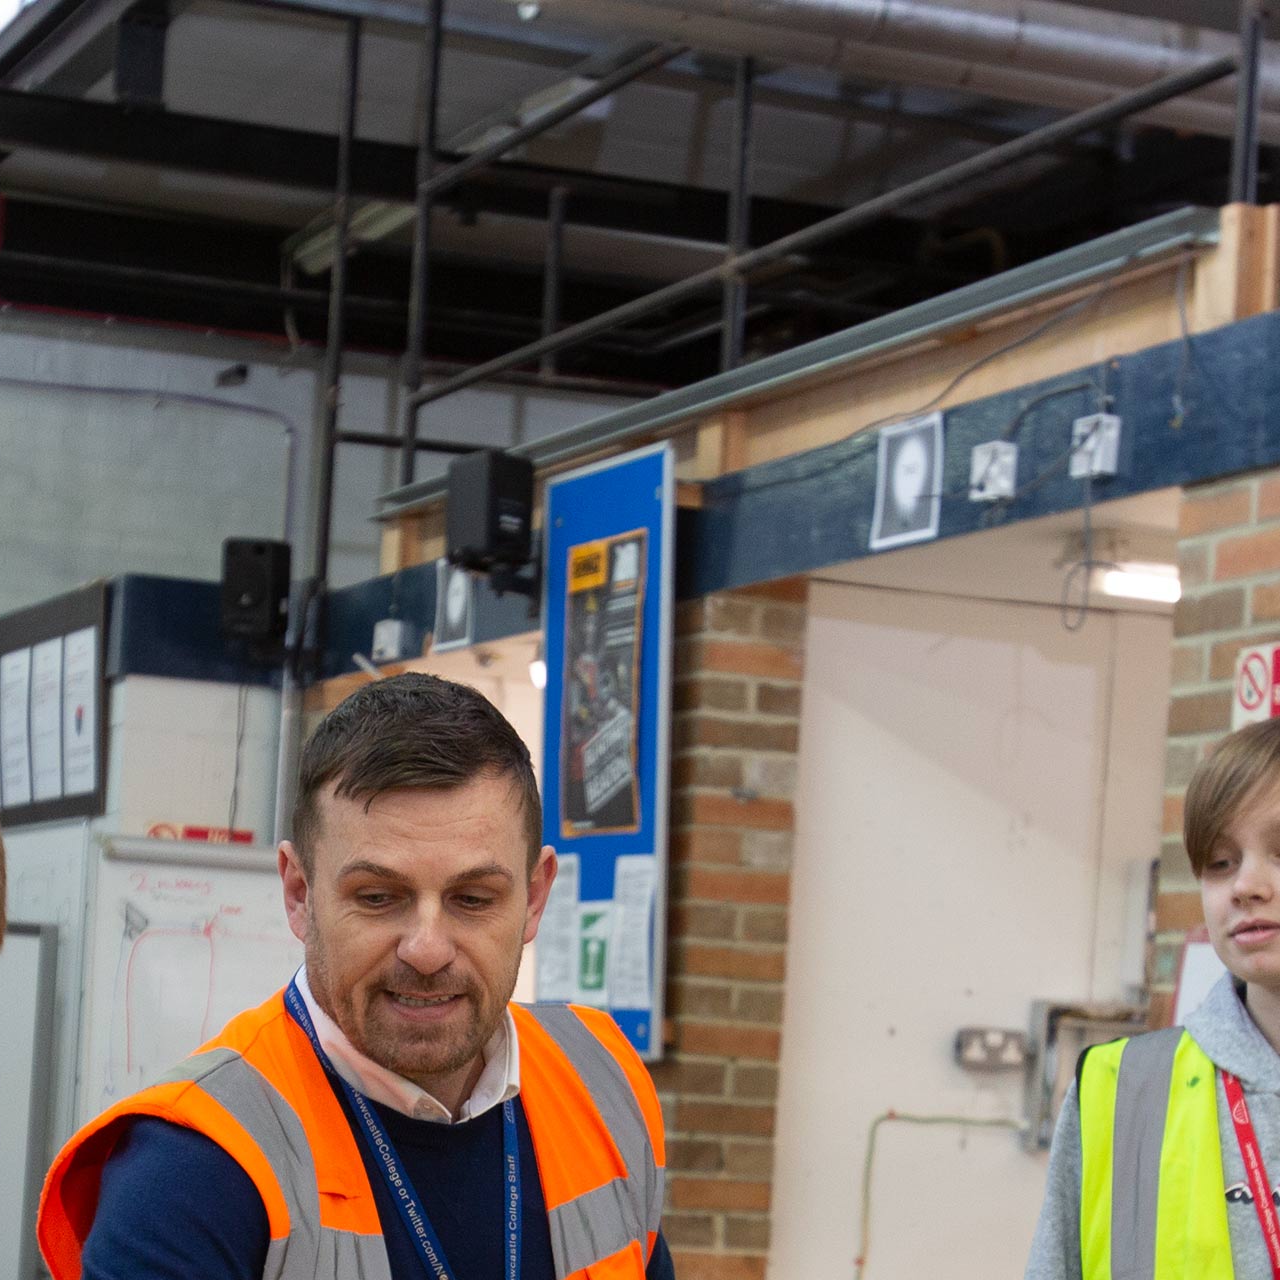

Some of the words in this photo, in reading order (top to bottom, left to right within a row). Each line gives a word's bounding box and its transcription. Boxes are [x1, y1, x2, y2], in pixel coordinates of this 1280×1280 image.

[507, 1155, 516, 1183] Staff
[397, 1186, 410, 1201] or
[508, 1186, 519, 1231] College
